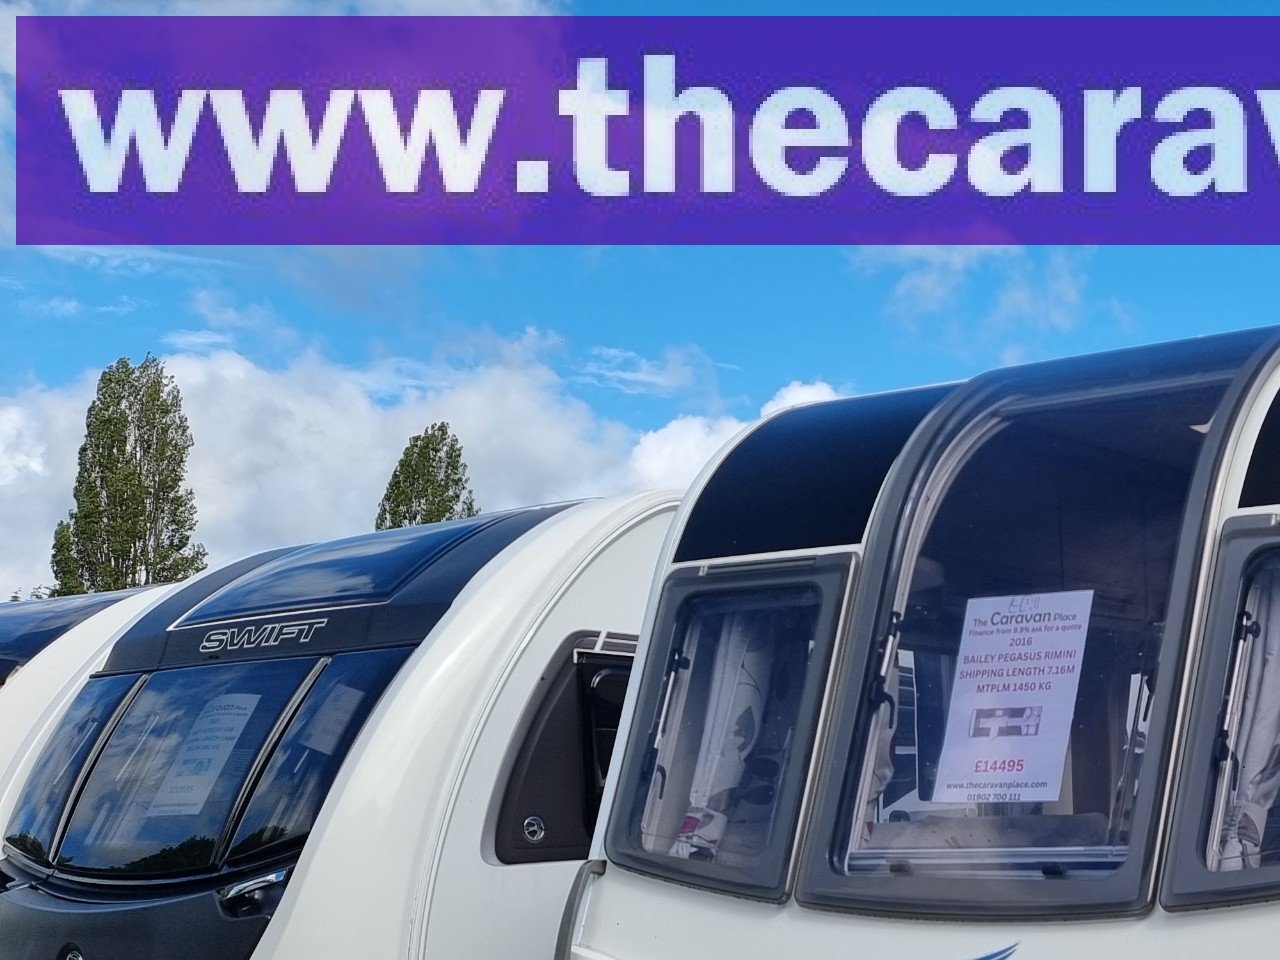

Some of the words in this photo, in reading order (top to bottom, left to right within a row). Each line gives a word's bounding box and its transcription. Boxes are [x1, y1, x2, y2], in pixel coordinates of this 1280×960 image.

[973, 618, 988, 627] The
[990, 611, 1052, 626] Caravan
[1053, 613, 1077, 622] Place
[200, 618, 328, 651] SWIFT
[969, 629, 995, 637] Finance
[996, 627, 1012, 635] from
[1031, 625, 1043, 633] ask
[1044, 624, 1054, 632] for
[1061, 623, 1082, 632] quote
[1009, 637, 1033, 647] 2016
[963, 653, 996, 665] BAILEY
[998, 651, 1042, 662] PEGASUS
[1044, 650, 1077, 660] RIMINI
[960, 668, 1004, 680] SHIPPING
[1006, 666, 1046, 677] LENGTH
[1047, 665, 1076, 675] 7.16M
[976, 683, 1011, 694] MTPLM
[1013, 682, 1036, 692] 1450
[1038, 681, 1052, 691] KG
[974, 759, 1025, 773] £14495
[946, 780, 1048, 790] www.thecaravanplace.com
[966, 793, 991, 801] 01902
[993, 793, 1008, 801] 700
[1009, 792, 1021, 801] 111
